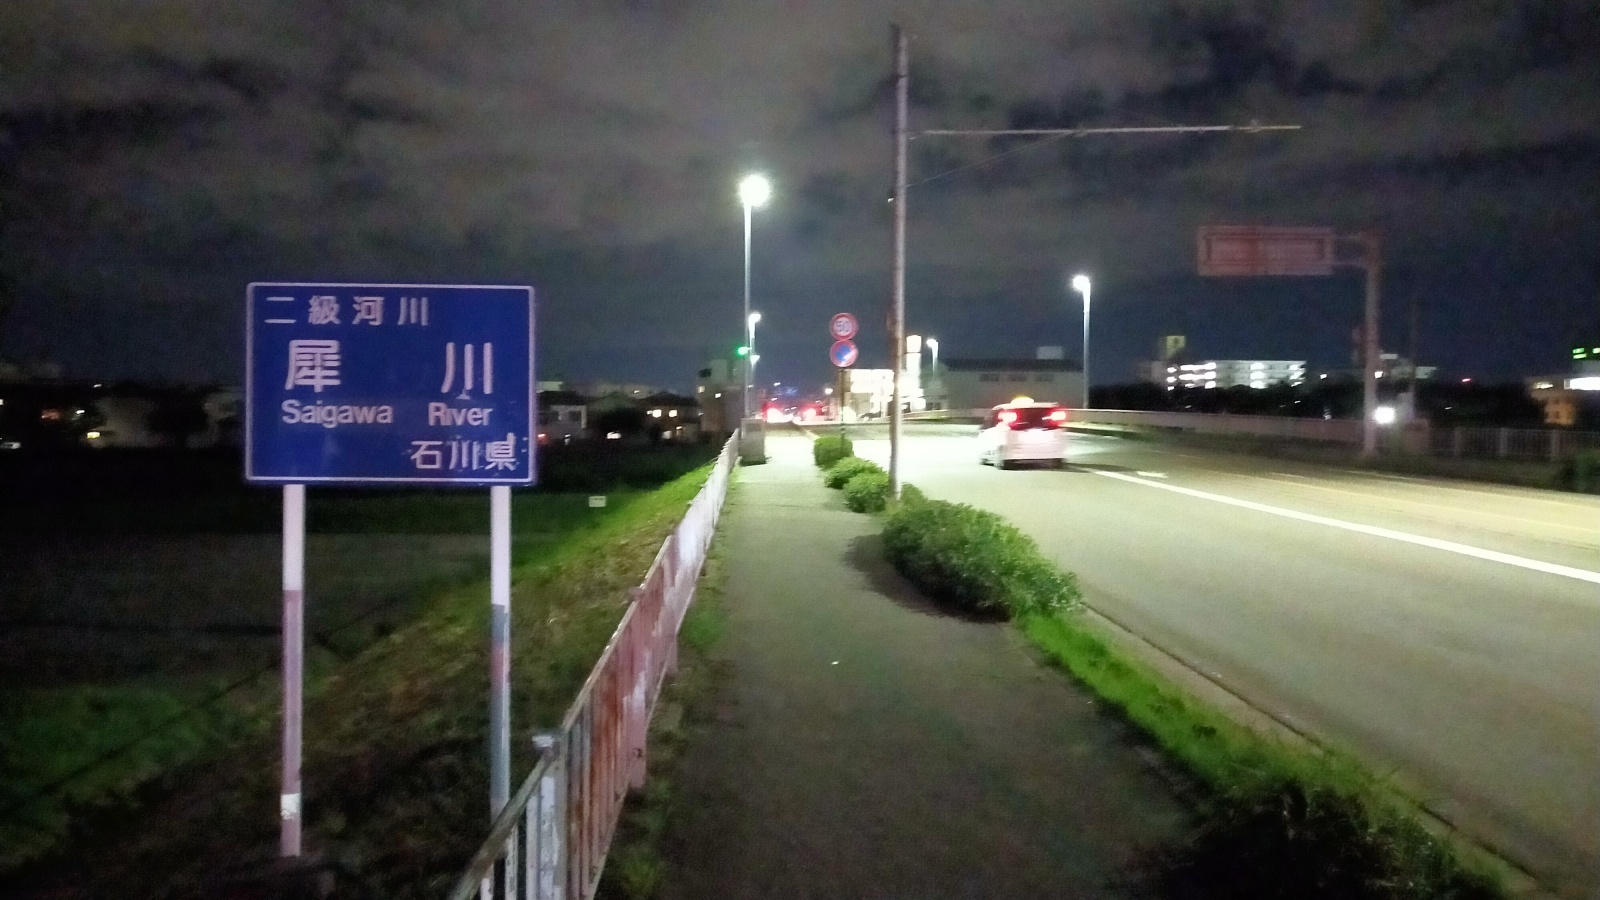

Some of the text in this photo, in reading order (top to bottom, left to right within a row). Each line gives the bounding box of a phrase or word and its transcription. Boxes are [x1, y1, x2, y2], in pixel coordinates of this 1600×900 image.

[264, 295, 429, 326] 二級河川
[281, 399, 493, 428] Saigawa River
[410, 433, 517, 470] 石川県
